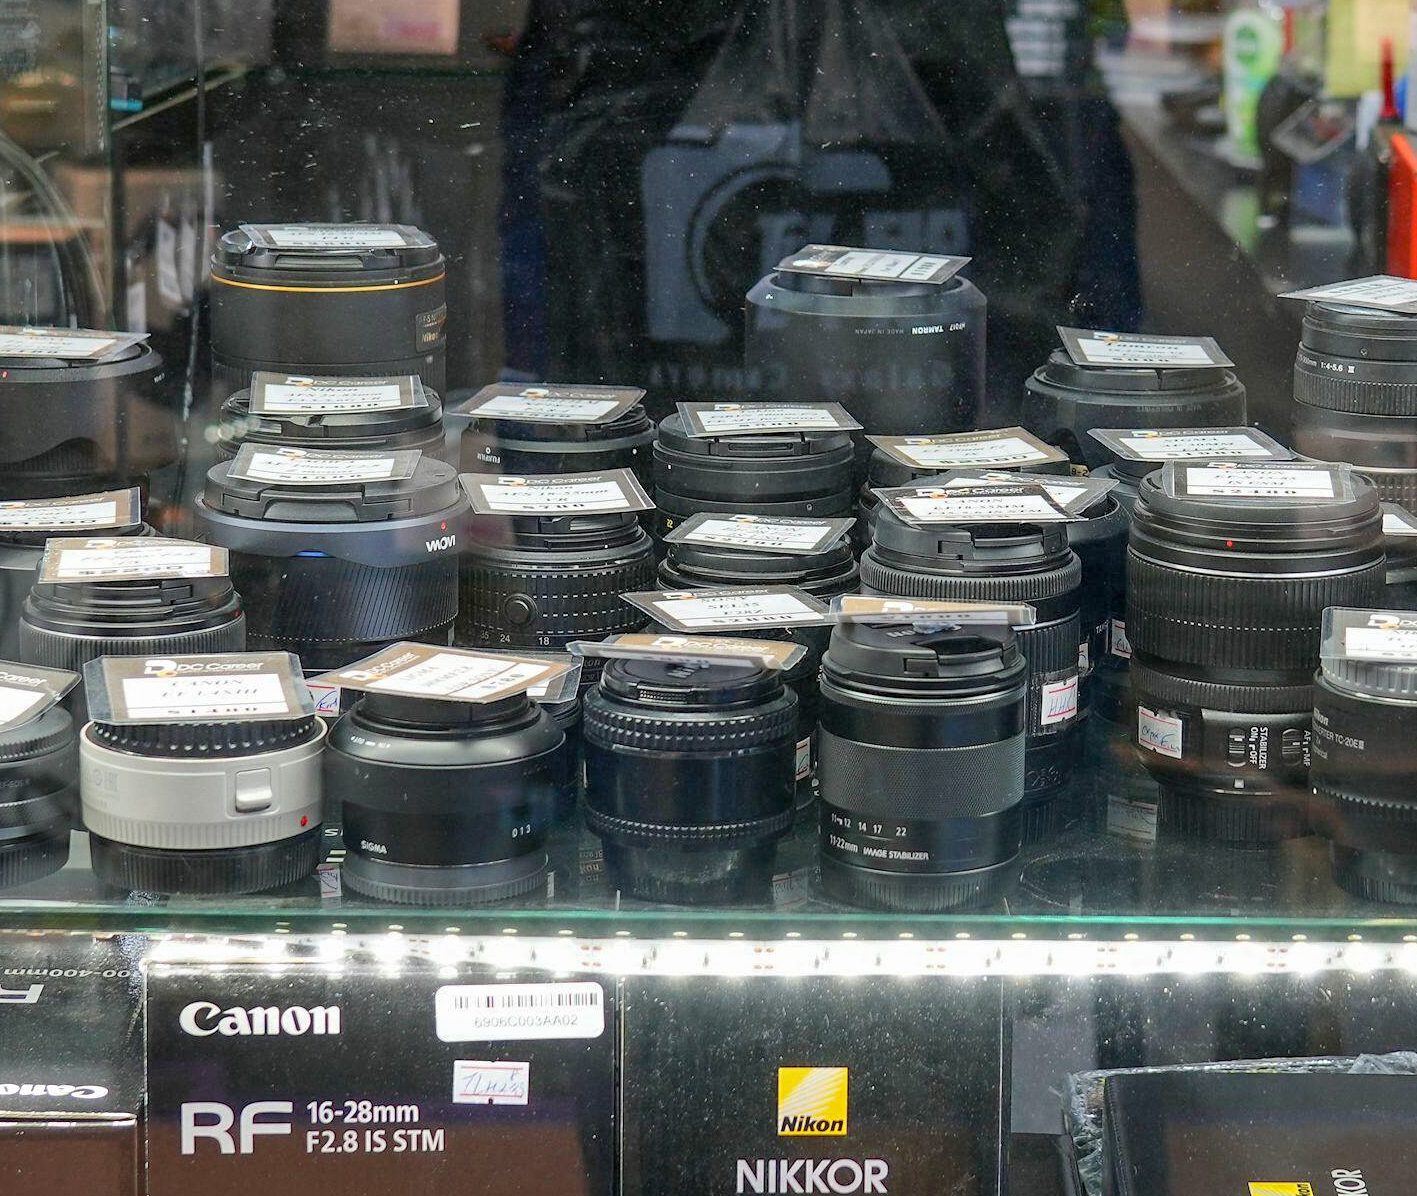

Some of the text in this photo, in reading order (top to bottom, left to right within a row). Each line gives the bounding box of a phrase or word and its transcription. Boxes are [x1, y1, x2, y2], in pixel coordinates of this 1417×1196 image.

[912, 325, 944, 335] TAMRON
[1258, 726, 1269, 770] STABILIZER
[360, 840, 388, 854] SIGMA
[829, 834, 859, 853] 11-22mm
[889, 850, 930, 860] STABILIZER
[179, 1001, 342, 1037] Canon
[306, 1100, 420, 1125] 16-28mm
[780, 1114, 844, 1135] Nikon
[181, 1100, 294, 1155] RF
[306, 1129, 446, 1154] F2.8 IS STM
[735, 1157, 889, 1195] NIKKOR
